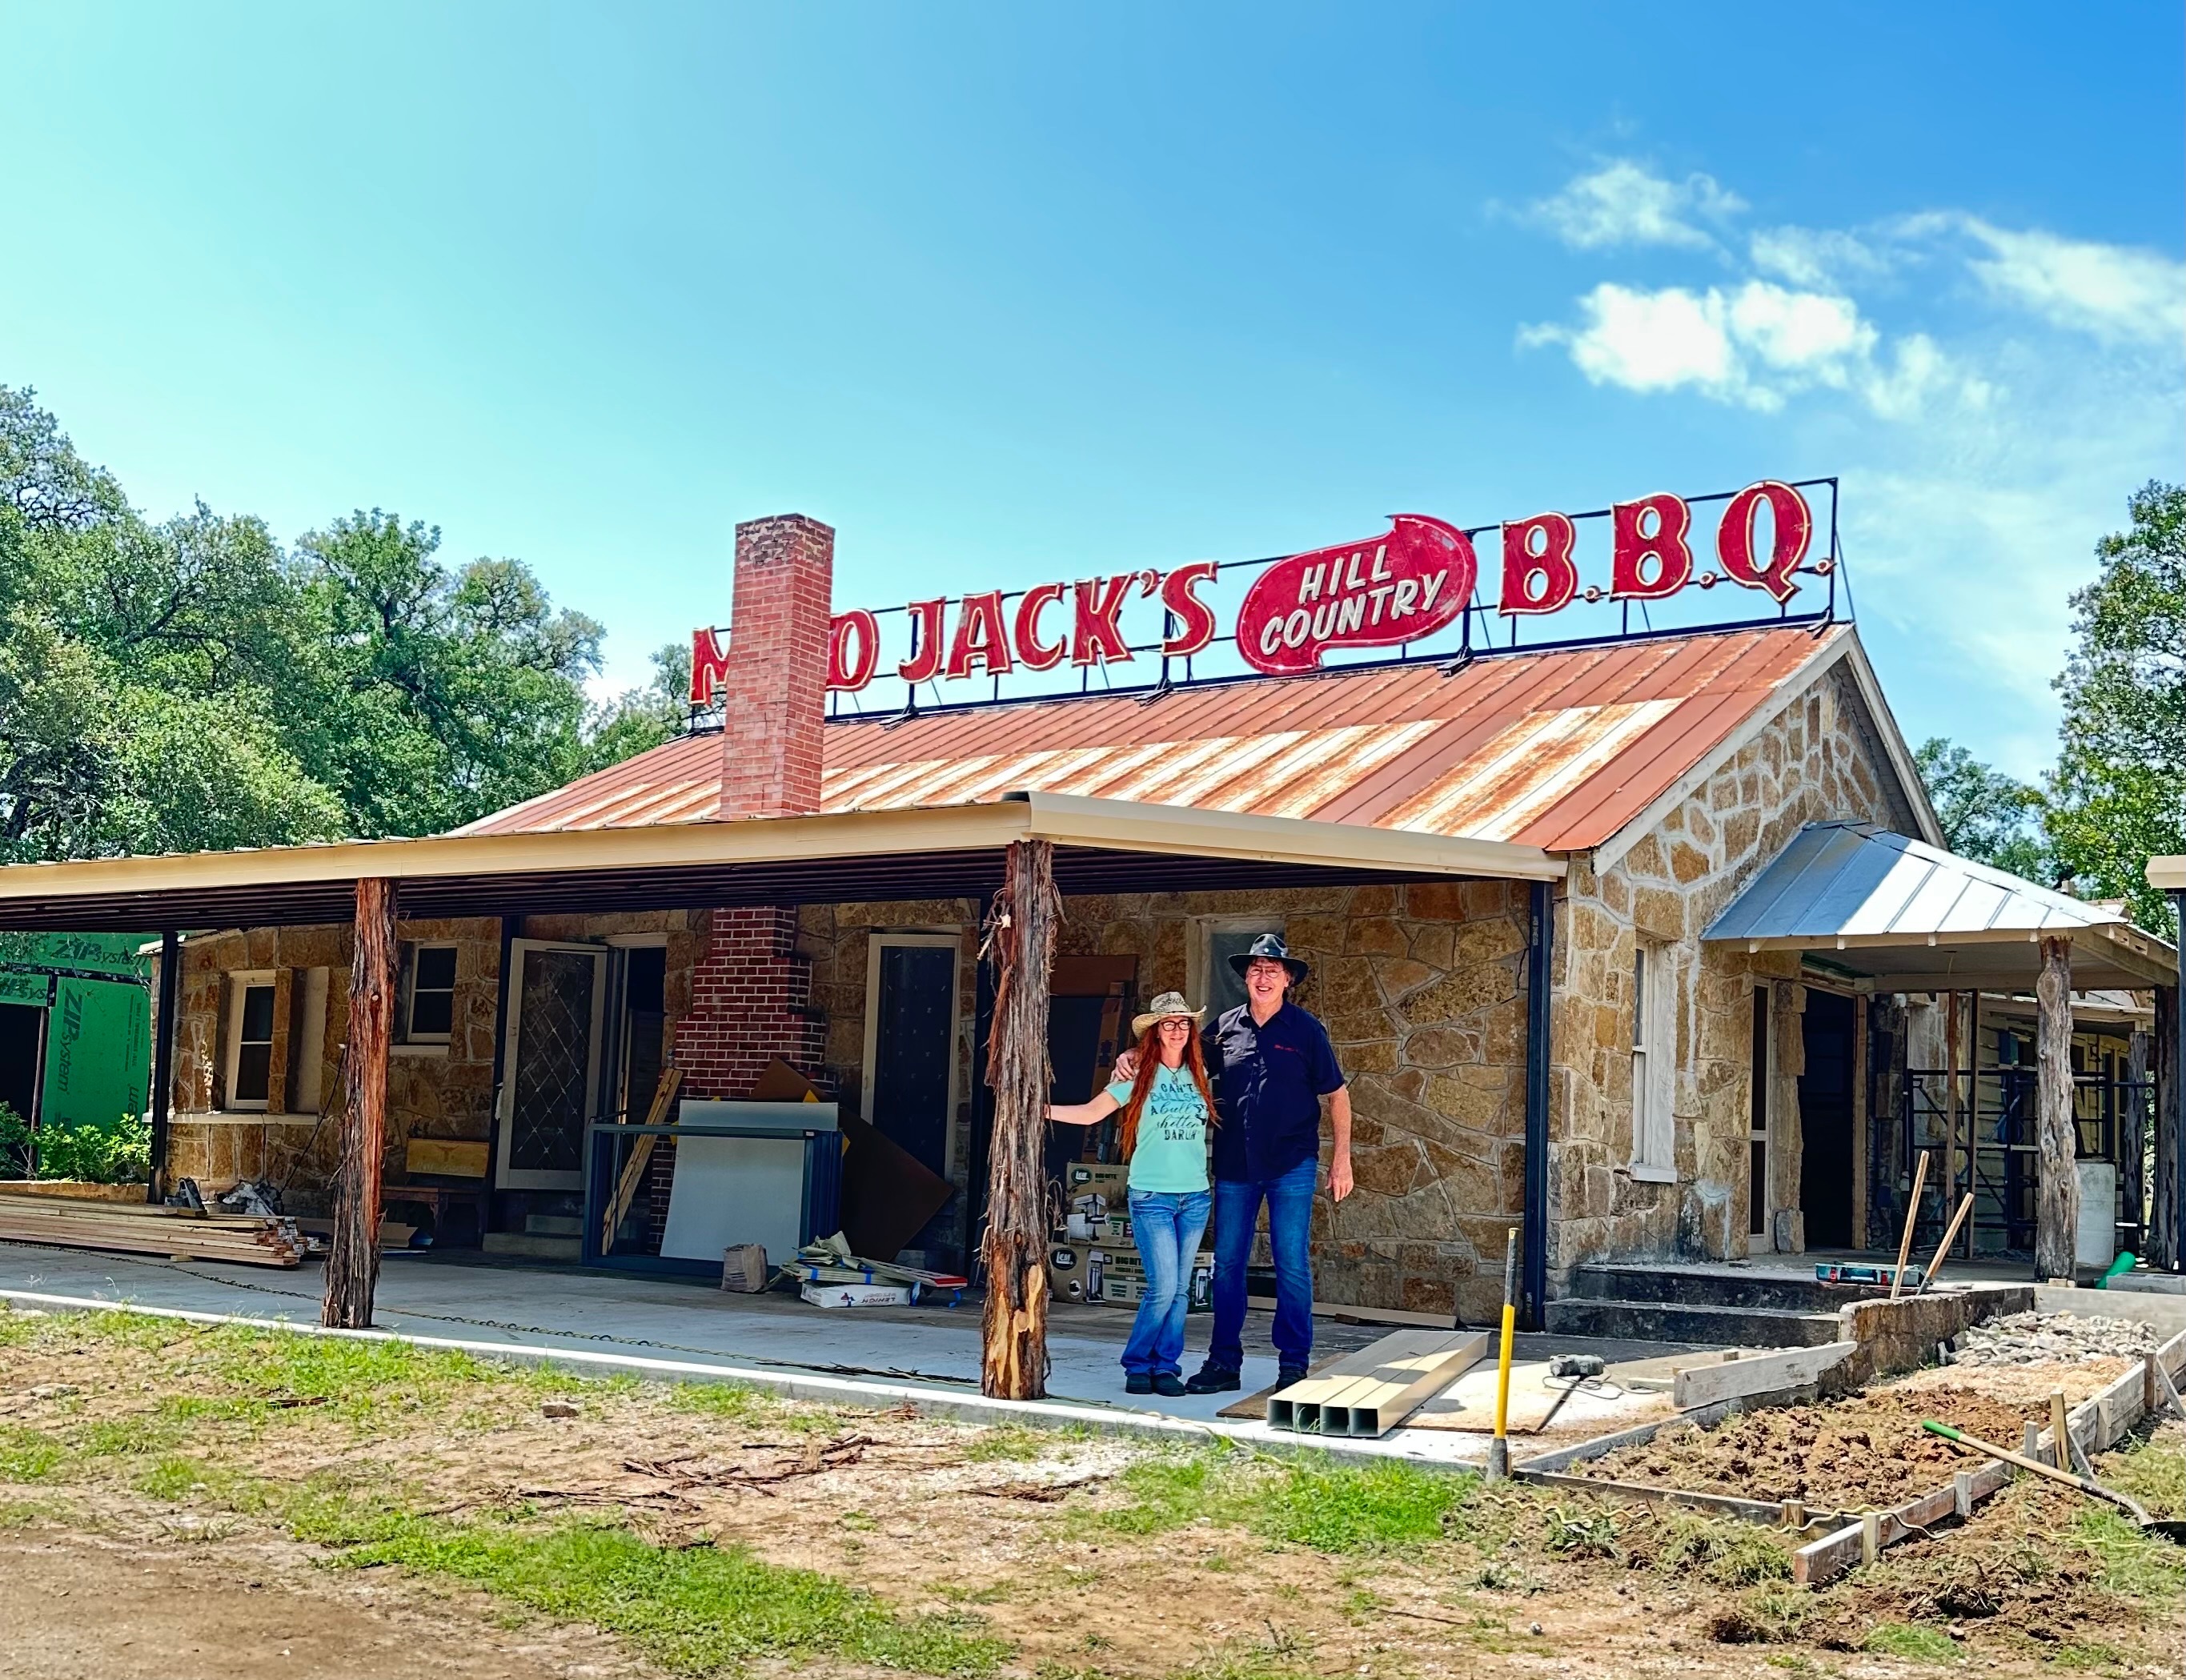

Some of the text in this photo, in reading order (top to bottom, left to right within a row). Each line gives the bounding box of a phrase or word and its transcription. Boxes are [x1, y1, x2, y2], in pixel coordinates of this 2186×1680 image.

[1299, 545, 1392, 604] HILL
[897, 560, 1221, 685] JACK'S
[1260, 570, 1448, 656] COUNTRY
[1160, 1083, 1194, 1093] CAN'T
